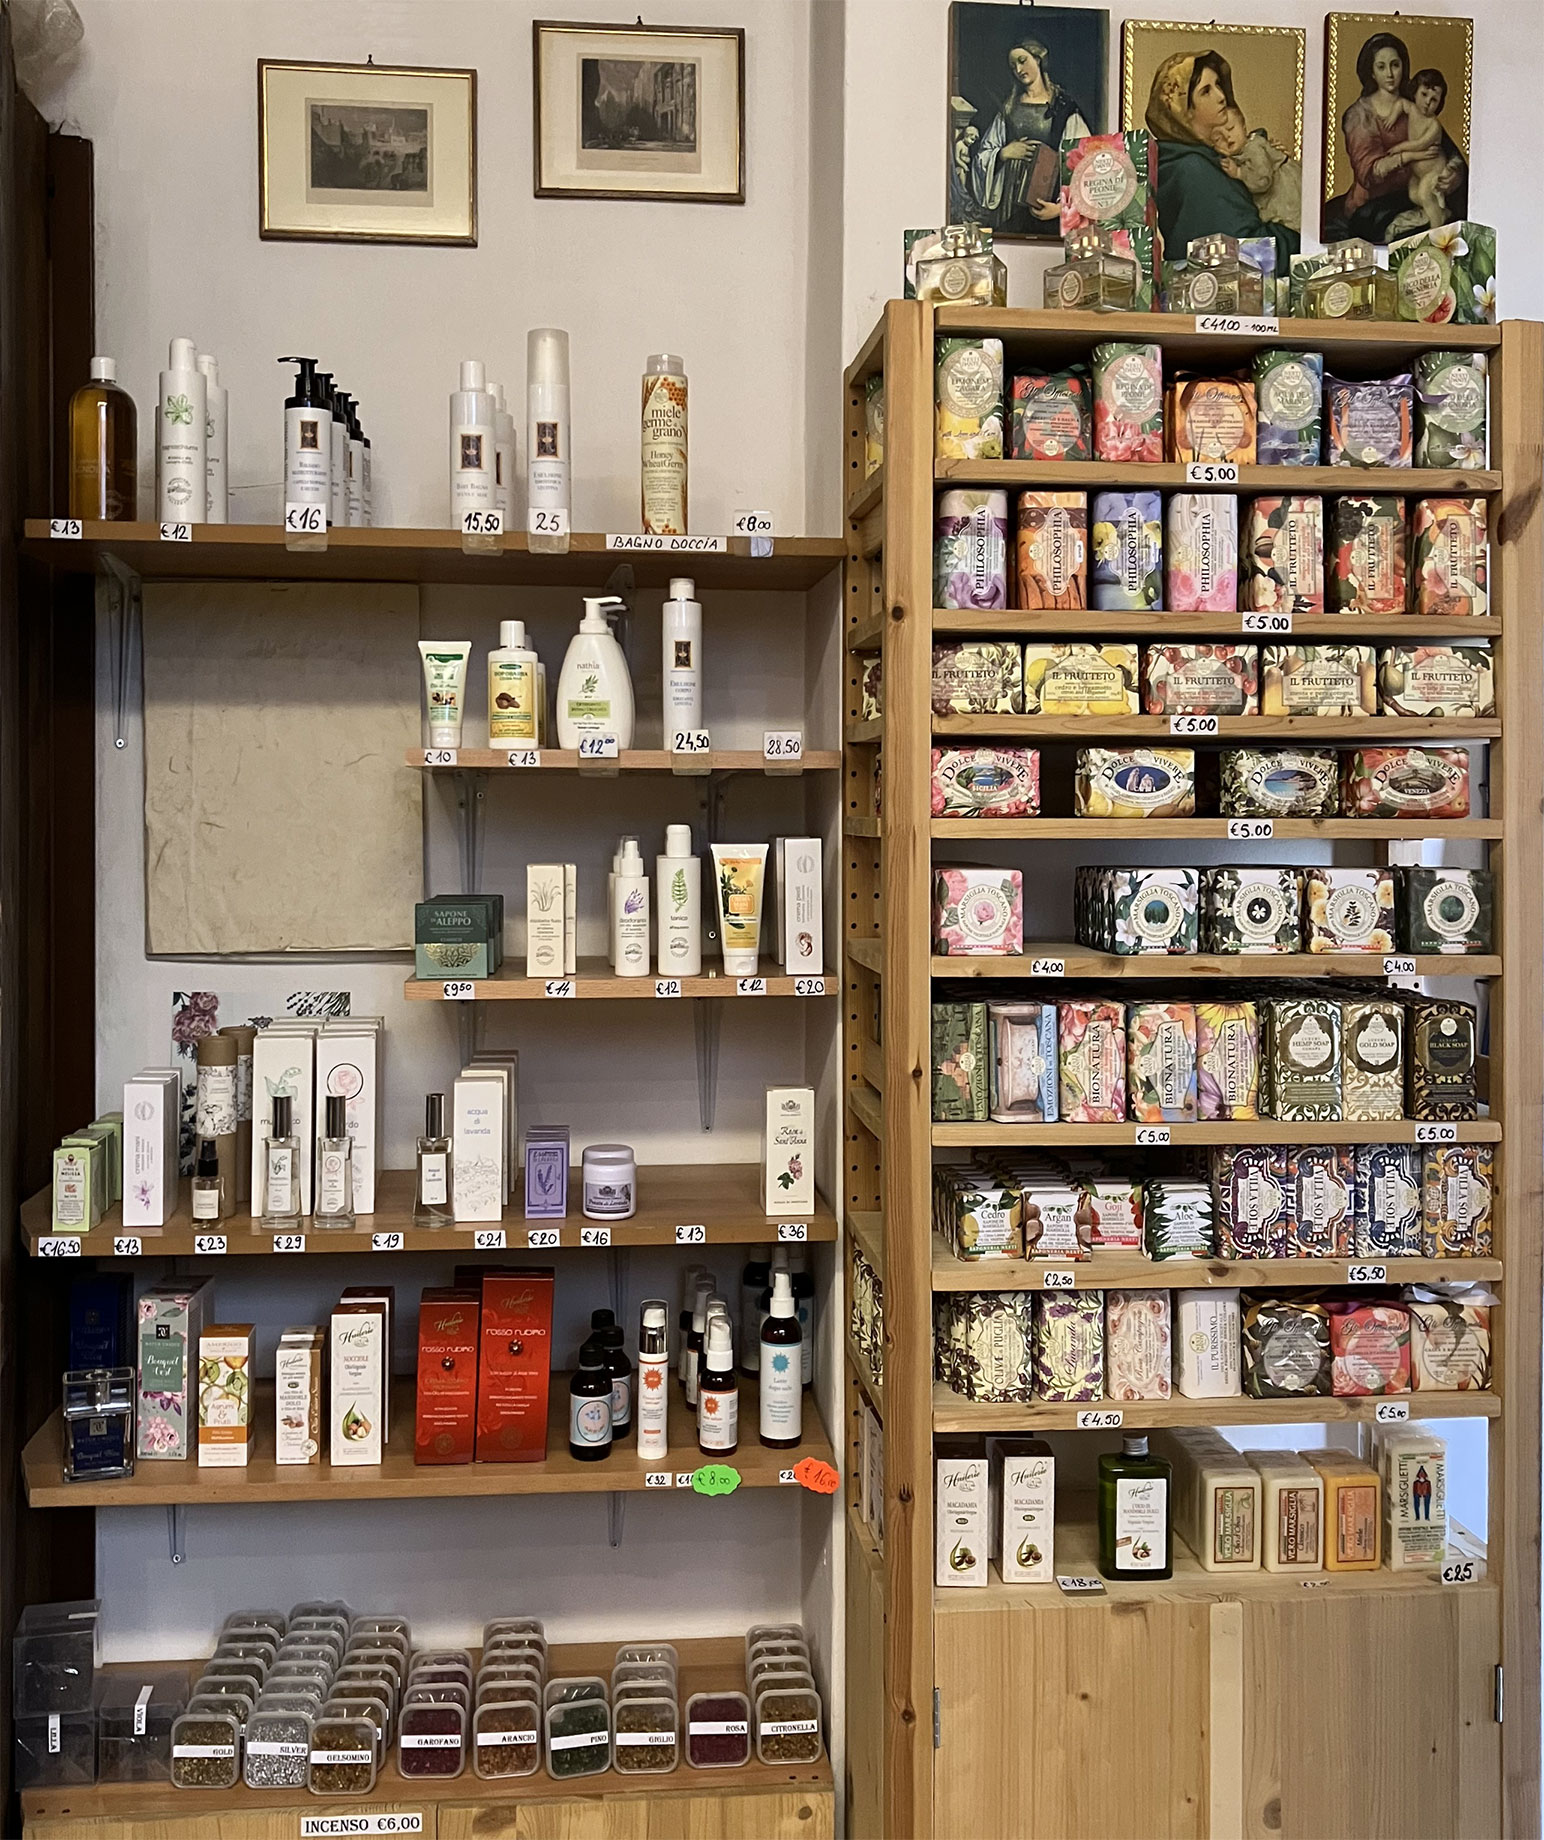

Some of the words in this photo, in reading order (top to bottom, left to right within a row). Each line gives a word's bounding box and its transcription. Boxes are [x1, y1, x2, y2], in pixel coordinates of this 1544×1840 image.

[652, 405, 681, 418] miele
[643, 418, 673, 432] germe
[652, 427, 682, 440] grano
[650, 451, 673, 462] Honey
[287, 507, 321, 531] €16
[464, 512, 500, 532] 15,50
[536, 512, 561, 532] 25
[51, 520, 81, 535] €13
[161, 524, 189, 540] €12
[614, 537, 663, 549] BAGNO
[976, 509, 986, 590] PHILOSOPHIA
[1289, 519, 1297, 574] FRUTTETO
[1450, 522, 1458, 574] FRUTTETO
[1053, 511, 1062, 591] PHILOSOPHIA
[1128, 511, 1137, 592] PHILOSOPHIA
[1201, 513, 1211, 593] PHILOSOPHIA
[1368, 523, 1376, 578] FRUTTETO
[1290, 577, 1297, 588] IL
[1368, 580, 1376, 591] IL
[1450, 579, 1458, 589] IL
[577, 660, 600, 670] nathia
[943, 669, 996, 679] FRUTTETO
[1052, 672, 1061, 680] IL
[1064, 672, 1116, 680] FRUTTETO
[1173, 677, 1183, 685] IL
[1185, 677, 1235, 685] FRUTTETO
[1411, 673, 1420, 681] IL
[1422, 673, 1473, 681] FRUTTETO
[1290, 678, 1300, 686] IL
[1302, 678, 1354, 686] FRUTTETO
[675, 733, 710, 752] 24,50
[425, 750, 452, 762] €10
[508, 753, 536, 765] €13
[942, 754, 976, 782] DOLCE
[996, 754, 1029, 783] VIVERE
[1102, 755, 1135, 781] DOLCE
[1153, 756, 1184, 784] VIVERE
[1251, 760, 1282, 786] DOLCE
[1300, 759, 1330, 786] VIVERE
[1374, 758, 1408, 784] DOLCE
[1426, 758, 1458, 785] VIVERE
[960, 887, 985, 917] MARSIGLIA
[1133, 888, 1159, 920] MARSIGLIA
[1236, 884, 1261, 915] MARSIGLIA
[1328, 888, 1354, 919] MARSIGLIA
[1427, 884, 1453, 917] MARSIGLIA
[434, 910, 467, 919] SAPONE
[437, 917, 472, 926] ALEPPO
[546, 981, 570, 996] €14
[656, 982, 680, 995] €12
[740, 979, 763, 991] €12
[796, 981, 824, 994] €20
[1046, 1013, 1054, 1060] TOSCANA
[1092, 1024, 1100, 1103] BIONATURA
[1228, 1023, 1236, 1102] BIONATURA
[1047, 1067, 1055, 1116] EMOZIONI
[467, 1109, 489, 1117] acqua
[474, 1117, 481, 1125] di
[464, 1127, 491, 1135] lavanda
[1250, 1168, 1259, 1200] VILLA
[1314, 1168, 1323, 1199] VILLA
[1386, 1169, 1395, 1200] VILLA
[1458, 1169, 1467, 1200] VILLA
[1105, 1202, 1123, 1213] Goji
[981, 1211, 1005, 1219] Cedro
[1045, 1214, 1072, 1223] Argan
[1174, 1212, 1194, 1220] Aloe
[1250, 1205, 1259, 1232] SOLE
[1314, 1204, 1323, 1231] SOLE
[1386, 1204, 1395, 1231] SOLE
[1458, 1204, 1467, 1231] SOLE
[477, 1232, 502, 1246] €21
[528, 1232, 557, 1245] €20
[582, 1232, 609, 1245] €16
[676, 1227, 704, 1241] €13
[778, 1225, 805, 1239] €36
[115, 1240, 139, 1254] €13
[197, 1238, 225, 1251] €23
[274, 1237, 302, 1249] €29
[372, 1234, 399, 1248] €19
[486, 1328, 513, 1336] rosso
[514, 1328, 546, 1336] rubino
[995, 1314, 1003, 1348] PUGLIA
[1210, 1315, 1219, 1363] PURISSIMO
[447, 1345, 474, 1353] rubino
[1064, 1321, 1076, 1376] Lavanda
[147, 1355, 179, 1369] Bouquet
[211, 1402, 235, 1410] Agrumi
[647, 1474, 665, 1485] €32
[1224, 1491, 1233, 1534] MARSIGLIA
[1288, 1492, 1297, 1536] MARSIGLIA
[1224, 1536, 1233, 1559] VERO
[1288, 1537, 1297, 1560] VERO
[1443, 1562, 1474, 1581] €25
[134, 1708, 143, 1733] VIOLA
[725, 1724, 745, 1732] ROSA
[771, 1723, 816, 1733] CITRONELLA
[417, 1737, 460, 1746] GAROFANO
[501, 1734, 535, 1743] ARANCIO
[590, 1735, 607, 1744] PINO
[648, 1735, 674, 1743] GIGLIO
[213, 1748, 233, 1756] GOLD
[280, 1746, 307, 1755] SILVER
[326, 1754, 370, 1762] GELSOMINO
[305, 1819, 369, 1834] INCENSO
[377, 1815, 420, 1831] €6,00
